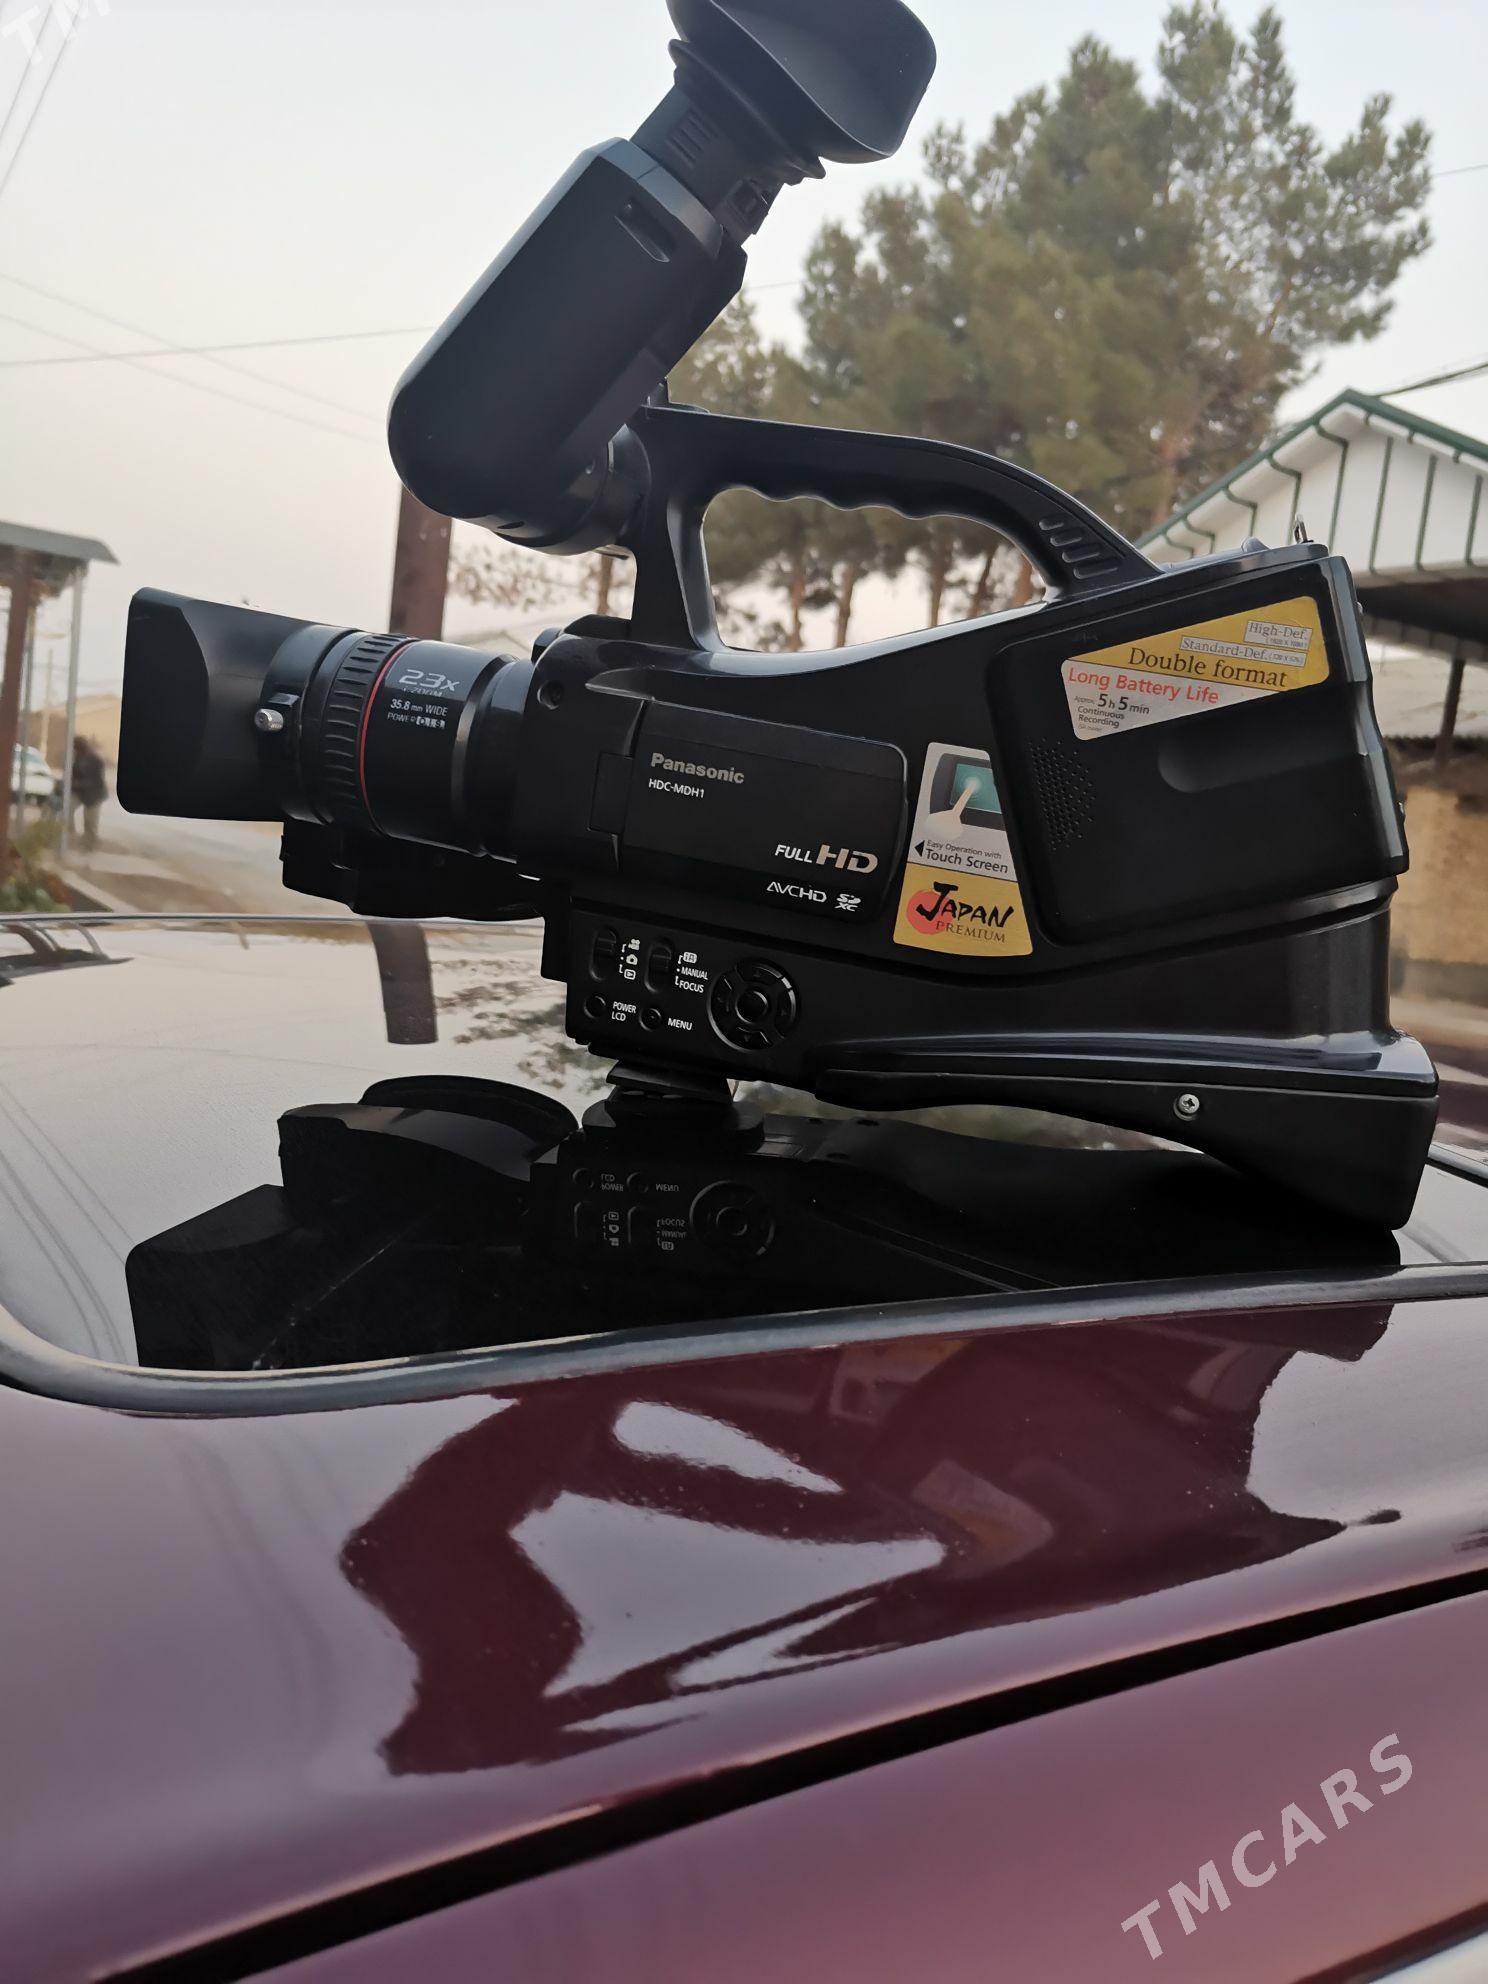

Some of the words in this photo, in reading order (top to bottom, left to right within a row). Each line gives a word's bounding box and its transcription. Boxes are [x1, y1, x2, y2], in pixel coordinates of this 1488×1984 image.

[1248, 622, 1308, 640] High-Def.
[1181, 639, 1268, 660] Standard-Def.
[1128, 647, 1206, 675] Double
[1213, 659, 1288, 688] format
[1068, 667, 1110, 691] Long
[1116, 674, 1181, 702] Battery
[1186, 685, 1219, 704] Life
[390, 698, 410, 711] 35.8
[425, 703, 449, 717] WIDE
[1077, 706, 1125, 720] Continuous
[1097, 693, 1108, 707] 5
[1108, 699, 1115, 709] h
[1118, 696, 1129, 711] 5
[1129, 704, 1150, 714] min
[1078, 714, 1119, 728] Recording
[650, 752, 745, 784] Panasonic
[648, 778, 705, 798] HDC-MDH1
[774, 844, 813, 864] FULL
[815, 844, 878, 874] HD
[926, 840, 943, 850] Easy
[945, 843, 982, 856] Operation
[984, 851, 1002, 859] with
[926, 848, 962, 865] Touch
[966, 856, 1008, 873] Screen
[766, 881, 828, 903] AVCHD
[915, 881, 1014, 928] JAPAN
[936, 920, 1006, 943] PREMIUM
[681, 966, 709, 980] MANUAL
[679, 980, 704, 993] FOCUS
[611, 1011, 626, 1022] LCD
[612, 1001, 637, 1014] POWER
[667, 1017, 693, 1031] MENU
